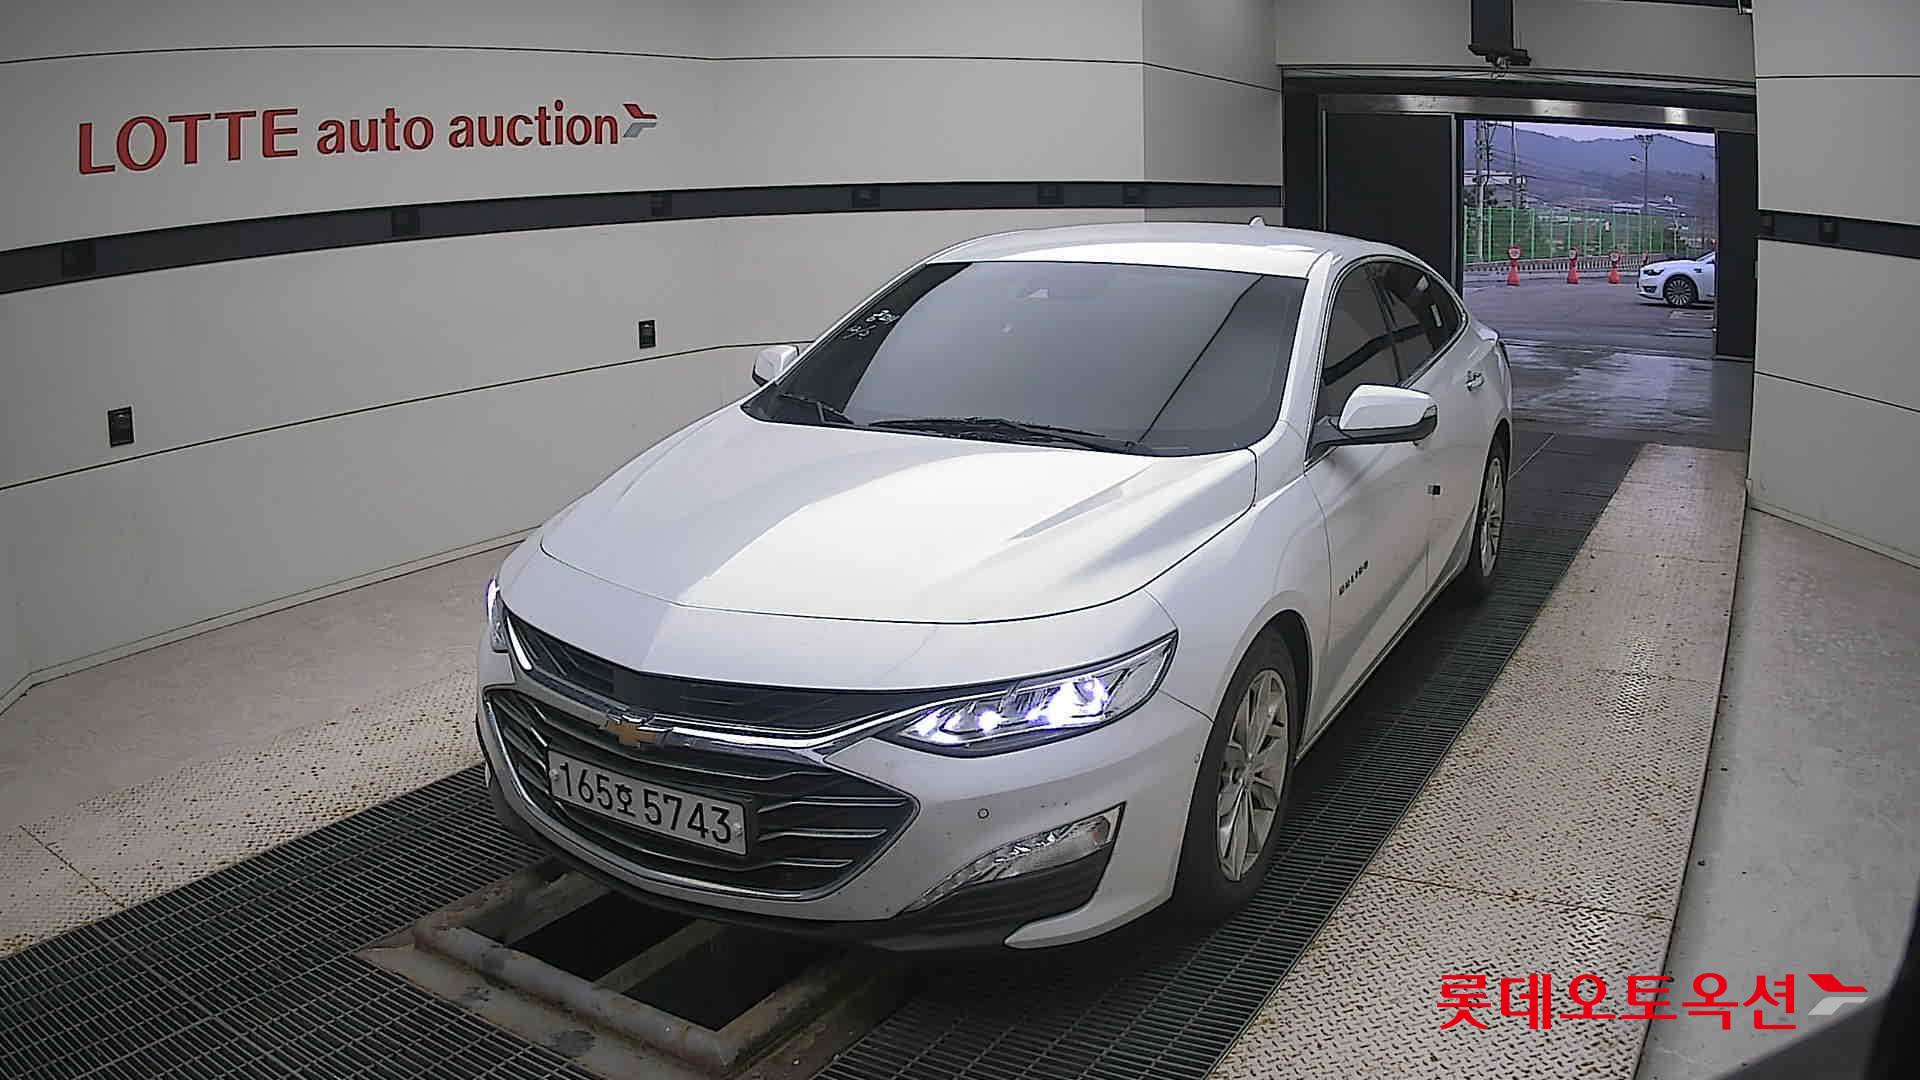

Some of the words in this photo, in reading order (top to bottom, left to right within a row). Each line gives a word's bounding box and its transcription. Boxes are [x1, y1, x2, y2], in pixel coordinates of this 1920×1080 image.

[78, 107, 299, 176] LOTTE
[316, 106, 435, 156] auto
[447, 99, 619, 149] auction
[643, 788, 732, 844] 5743
